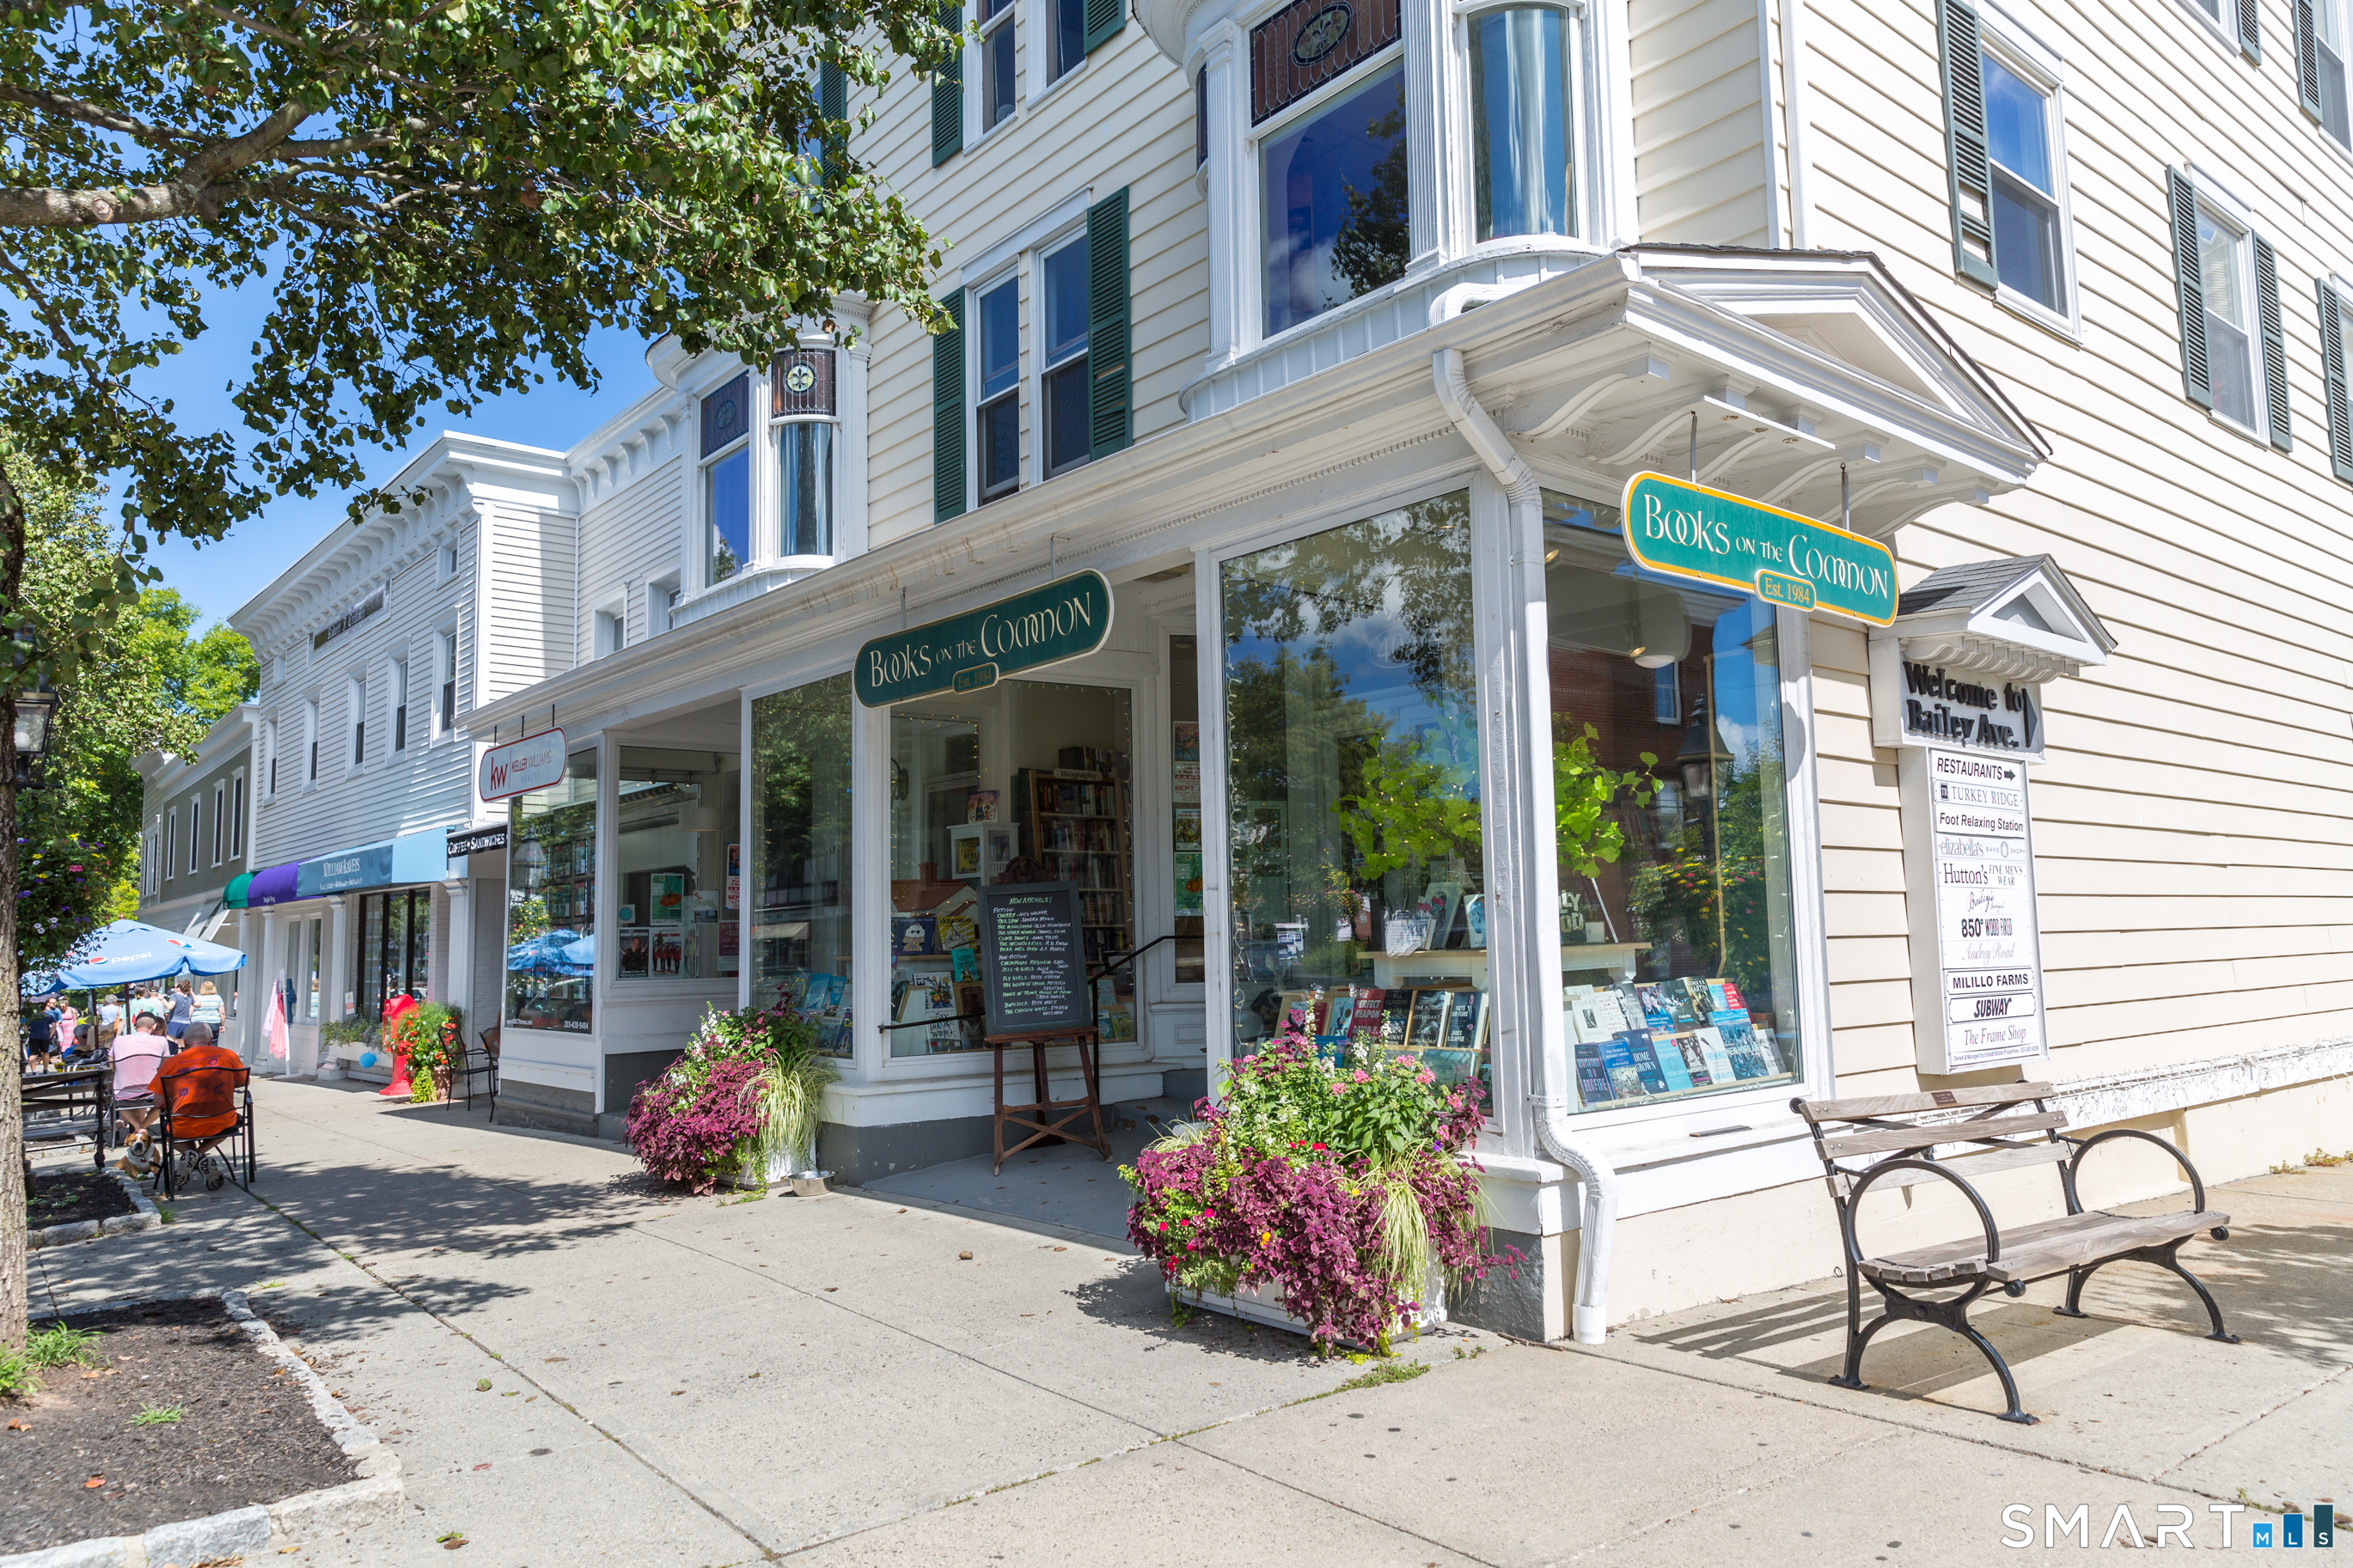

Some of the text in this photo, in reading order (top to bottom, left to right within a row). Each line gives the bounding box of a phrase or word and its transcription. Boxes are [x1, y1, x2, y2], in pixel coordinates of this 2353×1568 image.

[1644, 494, 1730, 555] BOOKS
[1736, 536, 1755, 555] ON
[1788, 534, 1887, 600] COMMON
[1764, 577, 1810, 604] Est. 1984
[870, 644, 932, 687] BOOKS
[936, 646, 952, 664] ON
[981, 592, 1091, 657] COMMON
[958, 669, 992, 689] Est. 1984
[1903, 662, 2024, 711] Welcome to
[1906, 699, 2019, 747] Bailey Ave.
[511, 750, 552, 773] KELLER WILLIAMS
[1937, 757, 2002, 780] RESTAURANTS
[491, 757, 508, 790] kw
[522, 773, 540, 783] REALTY
[1060, 770, 1097, 780] Biography
[1952, 786, 1988, 803] TURKEY
[1991, 791, 2019, 807] RIDGE
[1940, 813, 2023, 832] Foot Relaxing Station
[448, 841, 467, 854] COFFEE
[471, 833, 504, 850] SANDWICHES
[1941, 837, 1983, 857] elizabella's
[323, 861, 344, 877] WILLIAM
[1943, 863, 2022, 884] Hutton's FINE MEN'S
[1998, 876, 2014, 886] WEAR
[1967, 889, 1995, 912] Bailey's
[1962, 918, 2012, 937] 850° WOOD FIRED
[111, 951, 152, 964] pepsi
[1962, 942, 2015, 966] Audrey Road
[1953, 973, 2028, 988] MILILLO FARMS
[1354, 1010, 1380, 1018] WEAPON
[1973, 998, 2012, 1018] SUBWAY
[1965, 1025, 2026, 1045] The Frame Shop
[1633, 1052, 1651, 1062] HOME
[1706, 1051, 1727, 1060] FRENEMIES
[1635, 1061, 1656, 1072] GROWN
